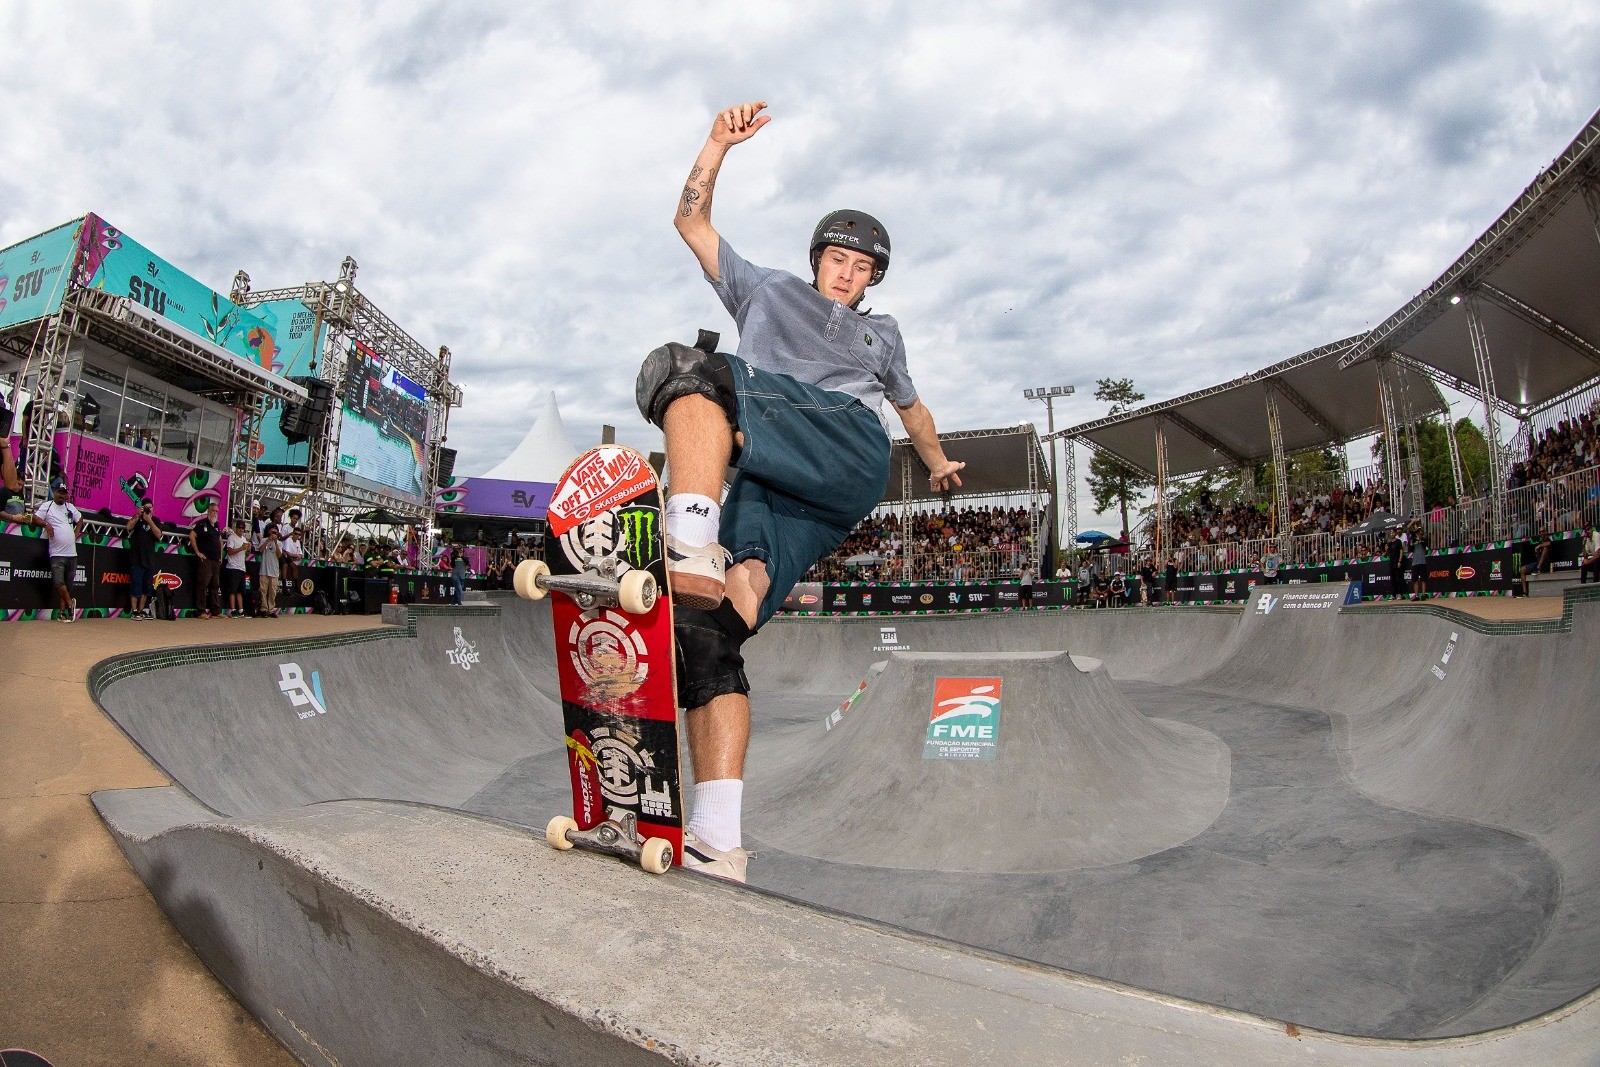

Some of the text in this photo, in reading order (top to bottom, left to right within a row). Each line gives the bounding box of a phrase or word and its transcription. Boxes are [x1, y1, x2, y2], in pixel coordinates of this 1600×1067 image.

[823, 232, 859, 244] MONSTER
[13, 267, 45, 302] STU
[128, 275, 167, 316] STU
[297, 311, 315, 319] MELHO
[299, 317, 315, 325] SKATE
[295, 324, 313, 332] TEMPO
[289, 332, 303, 340] TODO
[84, 449, 109, 467] MELHOR
[87, 463, 106, 478] SKATE
[570, 456, 605, 487] VANS
[580, 470, 610, 499] THE
[603, 450, 634, 482] WAL
[82, 475, 103, 490] TEMPO
[595, 477, 656, 511] SKATEBOARDIN
[13, 569, 52, 579] PETROBRAS
[101, 572, 131, 584] KENNE
[968, 593, 983, 602] STU
[1282, 592, 1307, 600] Financie
[446, 648, 480, 670] Tiger
[298, 709, 316, 719] banco
[933, 724, 993, 738] FME
